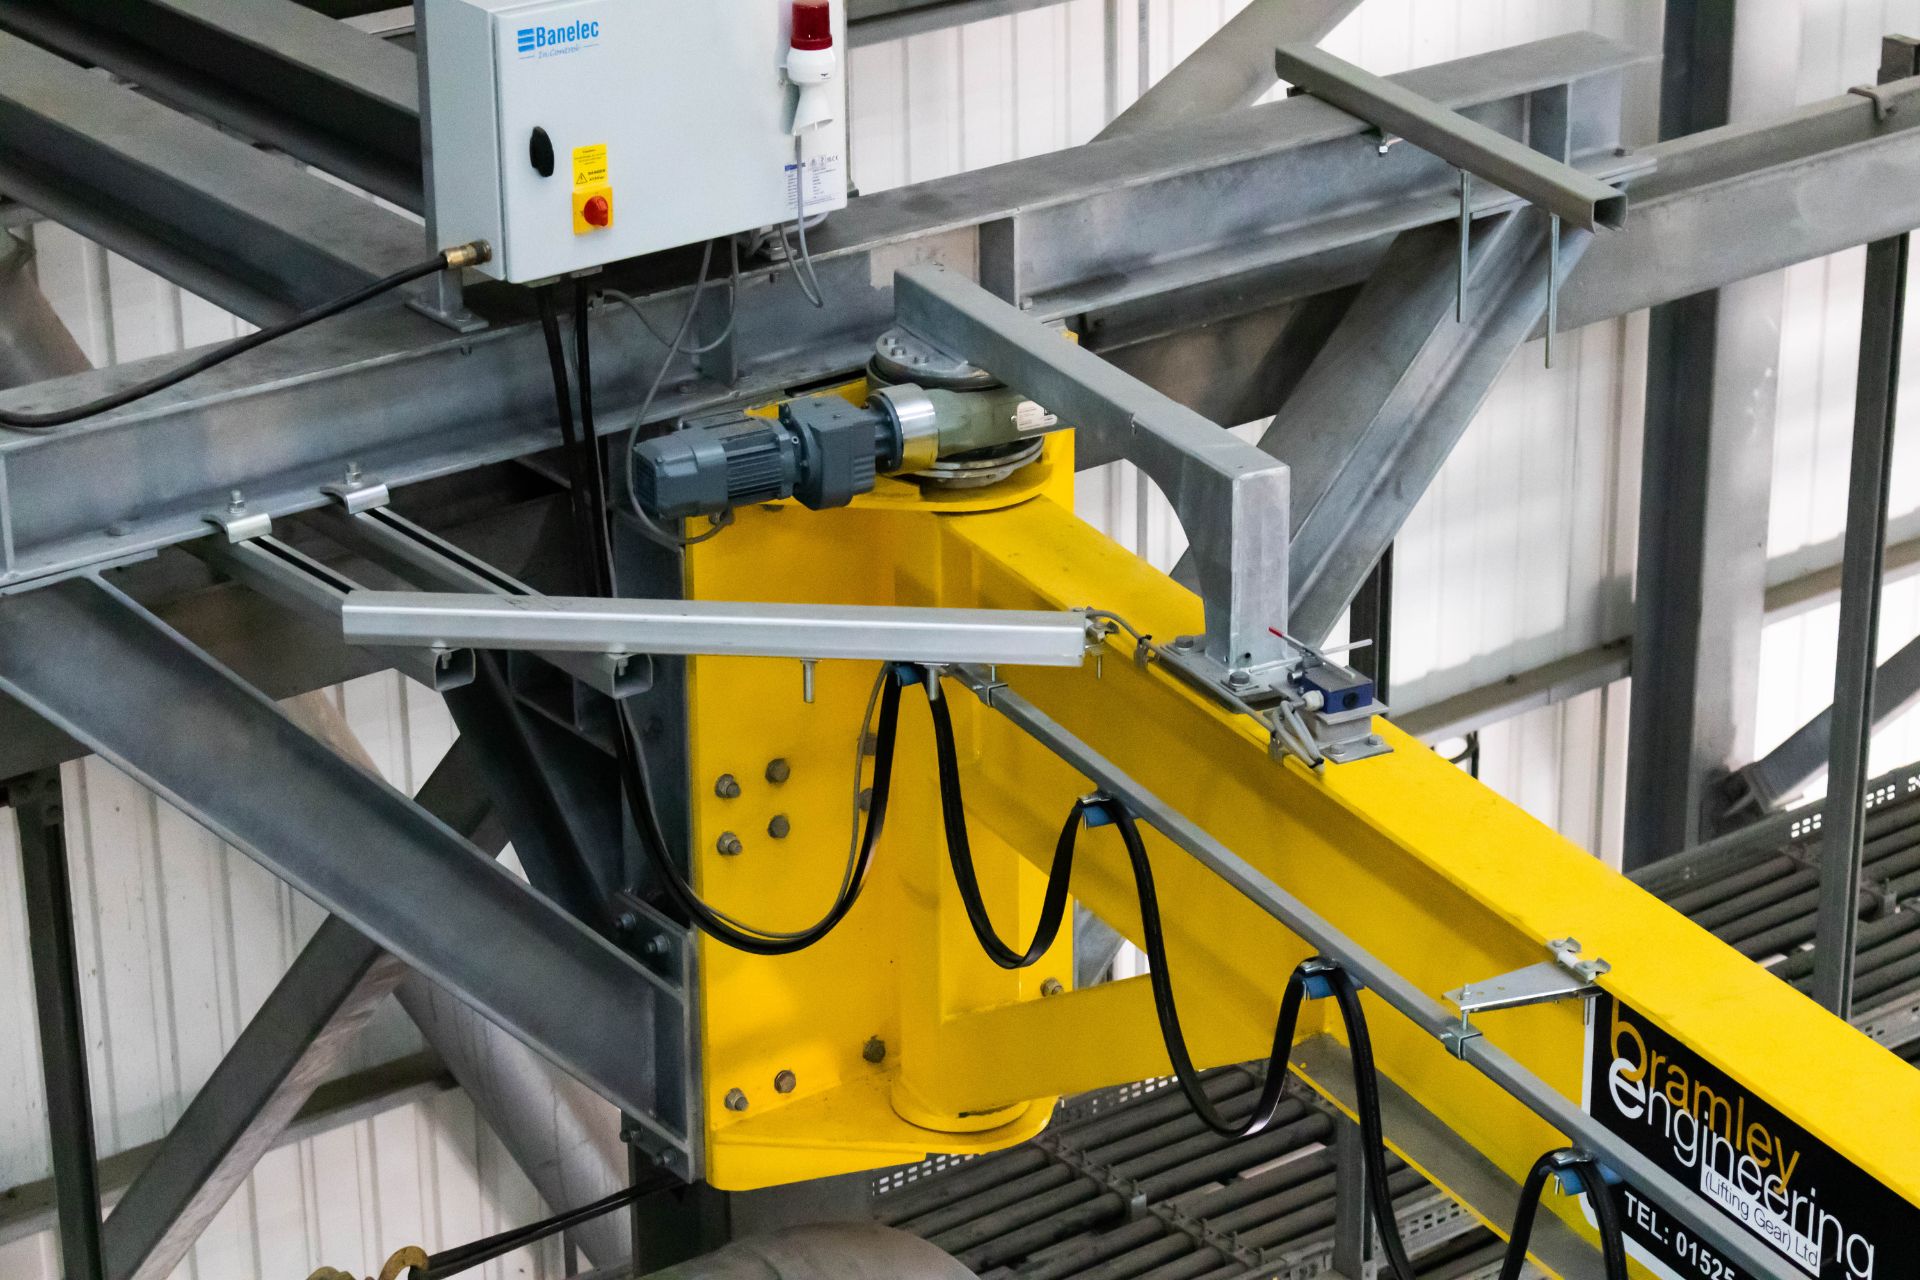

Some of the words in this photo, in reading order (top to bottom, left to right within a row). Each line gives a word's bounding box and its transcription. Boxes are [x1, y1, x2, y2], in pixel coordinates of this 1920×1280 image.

[536, 20, 599, 47] Banelec
[1610, 999, 1800, 1195] bramley
[1608, 1057, 1875, 1280] engineering
[1624, 1190, 1669, 1245] TEL:
[1704, 1171, 1749, 1221] (Lifting
[1753, 1207, 1792, 1251] Gear)
[1795, 1236, 1819, 1267] Ltd
